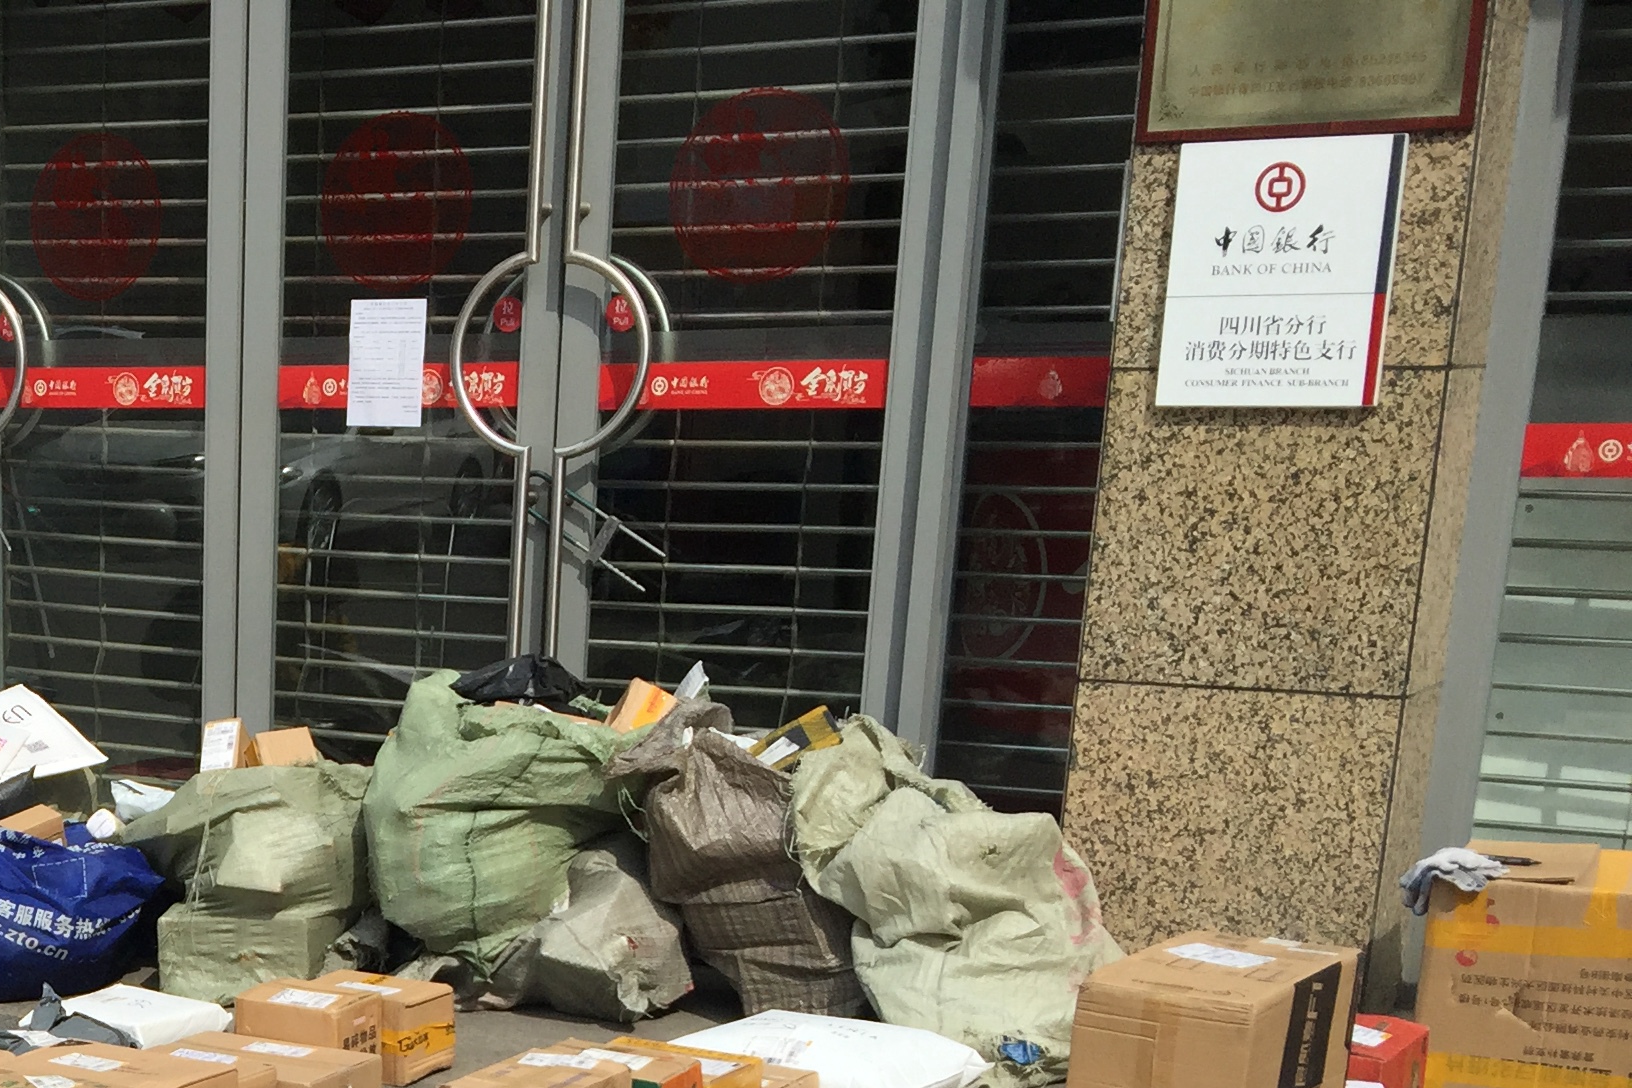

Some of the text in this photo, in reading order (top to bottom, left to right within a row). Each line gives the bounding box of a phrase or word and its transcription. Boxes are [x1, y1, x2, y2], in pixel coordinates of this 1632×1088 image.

[1215, 224, 1336, 257] 中国银行
[1211, 262, 1332, 276] BANK OF CHINA
[500, 318, 515, 327] Pull
[613, 316, 629, 325] Pull
[1219, 315, 1327, 336] 四川省分行
[1185, 340, 1358, 361] 消费分期特色支行
[1225, 367, 1310, 376] SICHUAN BRANCH
[671, 376, 709, 388] 中国银行
[1185, 378, 1349, 387] CONSUMER FINANCE SUB-BRANCH
[1296, 982, 1322, 1087] 启航者F1
